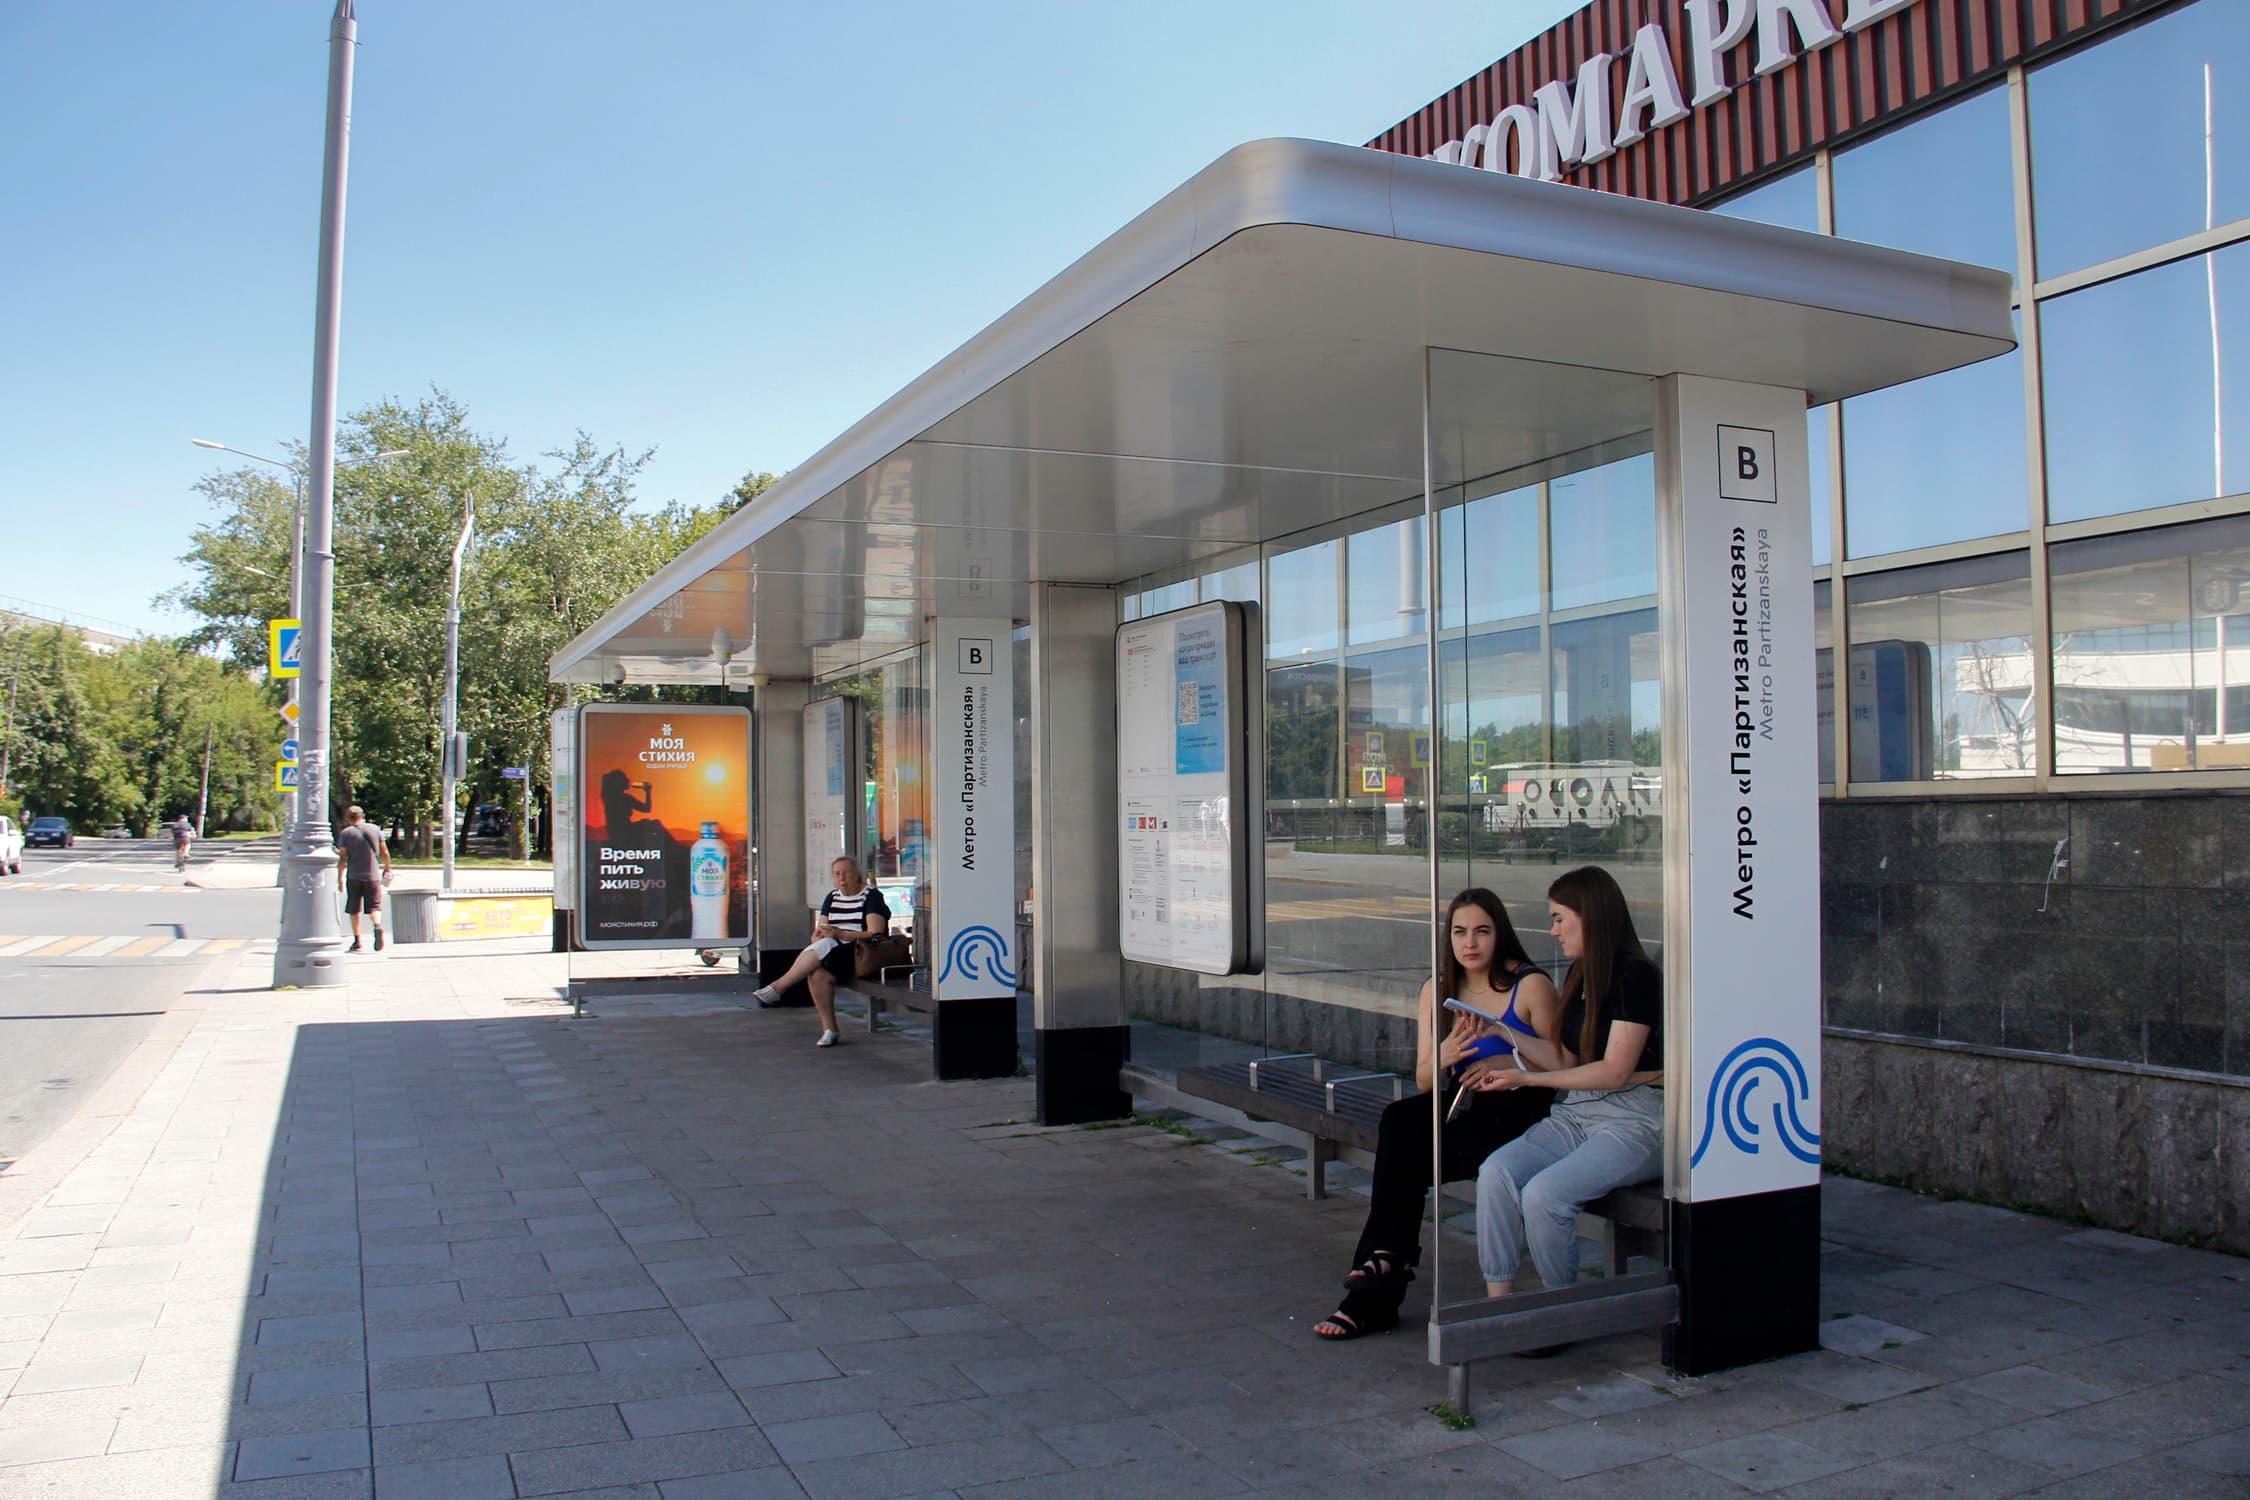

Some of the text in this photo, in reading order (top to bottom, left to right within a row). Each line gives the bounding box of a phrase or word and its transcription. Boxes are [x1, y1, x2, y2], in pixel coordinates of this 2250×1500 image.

[1737, 445, 1759, 481] В
[1756, 528, 1776, 741] Metro Partizanskaya
[969, 647, 983, 665] В
[1730, 526, 1757, 920] Метро «Партизанская»
[649, 738, 685, 750] МОЯ
[977, 686, 988, 788] Metro Partizanskaya
[639, 751, 697, 763] СТИХИЯ
[961, 686, 977, 871] Метро «Партизанская»
[600, 847, 662, 862] Время
[600, 864, 645, 875] пить
[600, 879, 667, 892] живую
[484, 909, 513, 922] ЛЕТО
